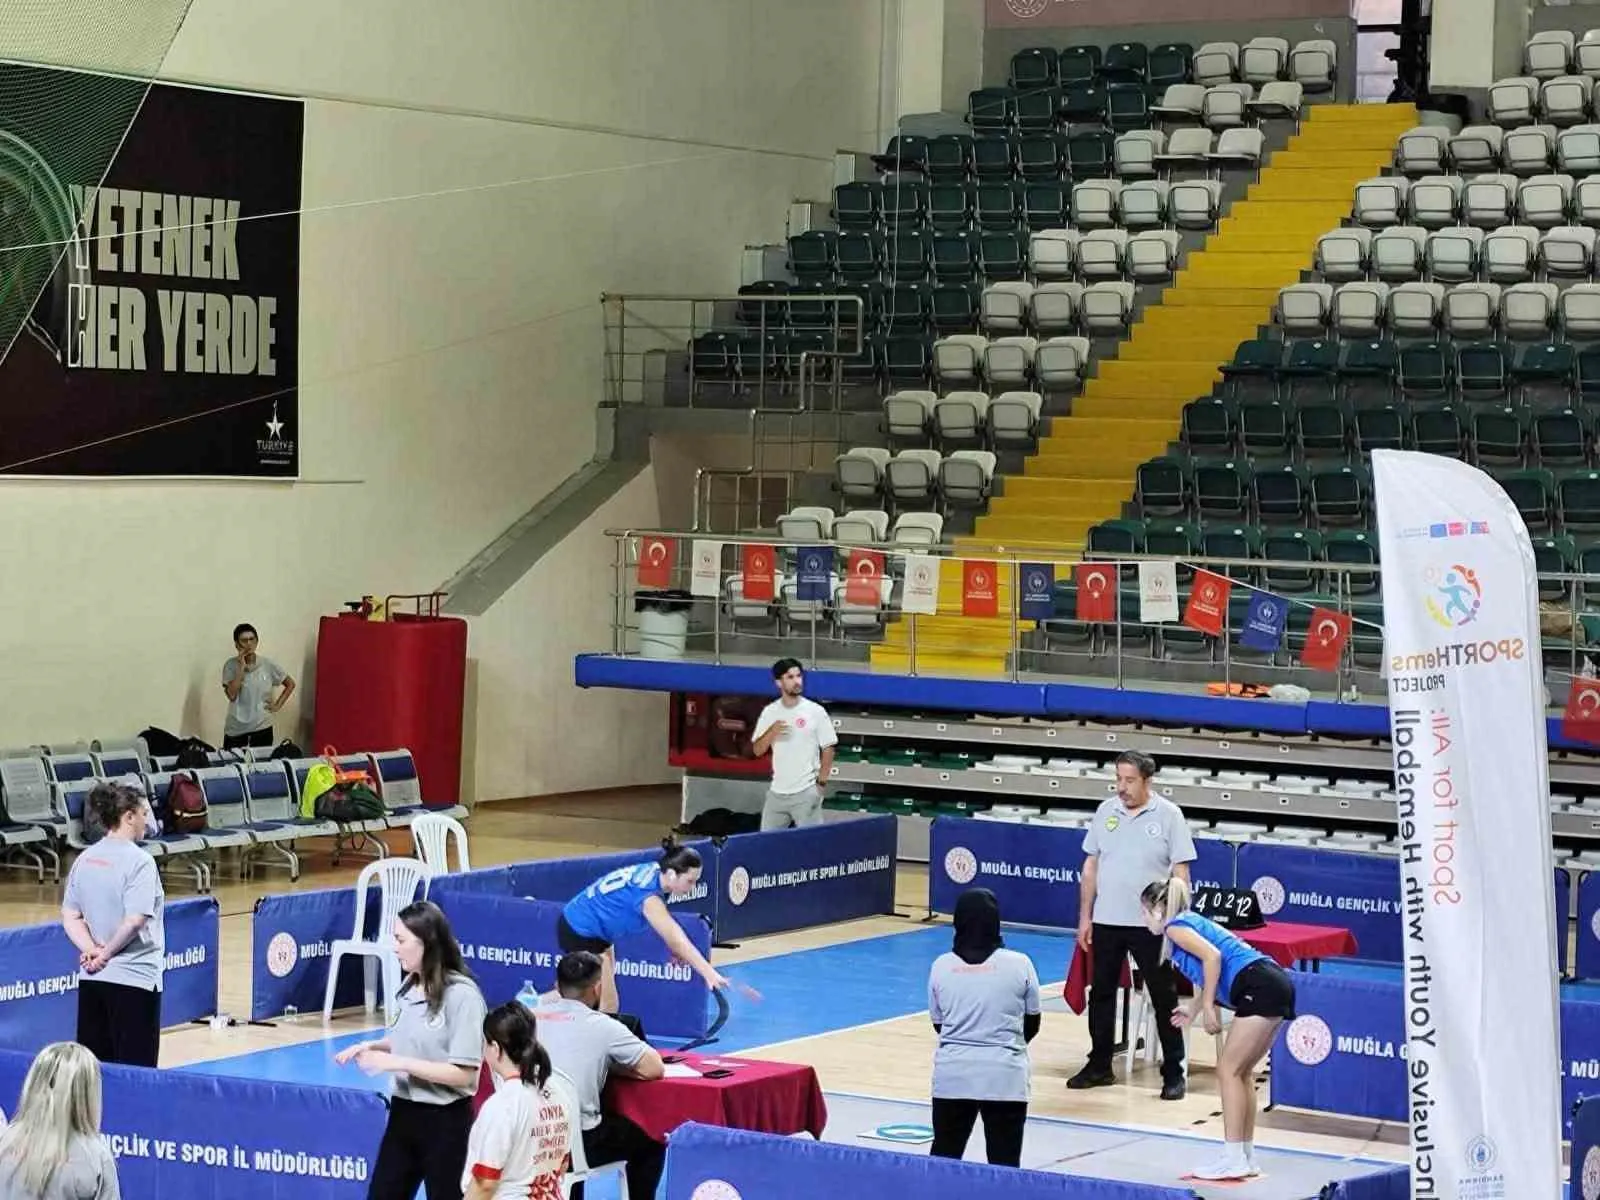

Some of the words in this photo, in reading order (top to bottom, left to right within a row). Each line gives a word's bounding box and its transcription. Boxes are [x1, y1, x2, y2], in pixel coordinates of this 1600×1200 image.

[69, 184, 241, 281] YETENEK
[68, 284, 147, 371] HER
[157, 289, 277, 376] YERDE
[819, 865, 838, 880] SPOR
[981, 861, 1021, 878] MUĞLA
[1024, 865, 1073, 884] GENÇLİK
[1195, 892, 1208, 913] 4
[1213, 892, 1222, 908] 0
[1225, 893, 1235, 909] 2
[1236, 896, 1252, 917] 12
[1289, 891, 1333, 909] MUĞLA
[1336, 895, 1391, 915] GENÇLİK
[300, 940, 334, 959] MUĞL
[478, 943, 532, 966] GENÇLİK
[535, 952, 552, 968] VE
[1338, 1035, 1395, 1058] MUĞLA
[154, 1139, 176, 1161] VE
[181, 1143, 228, 1168] SPOR
[233, 1144, 250, 1169] İL
[255, 1149, 368, 1182] MÜDÜRLÜĞÜ
